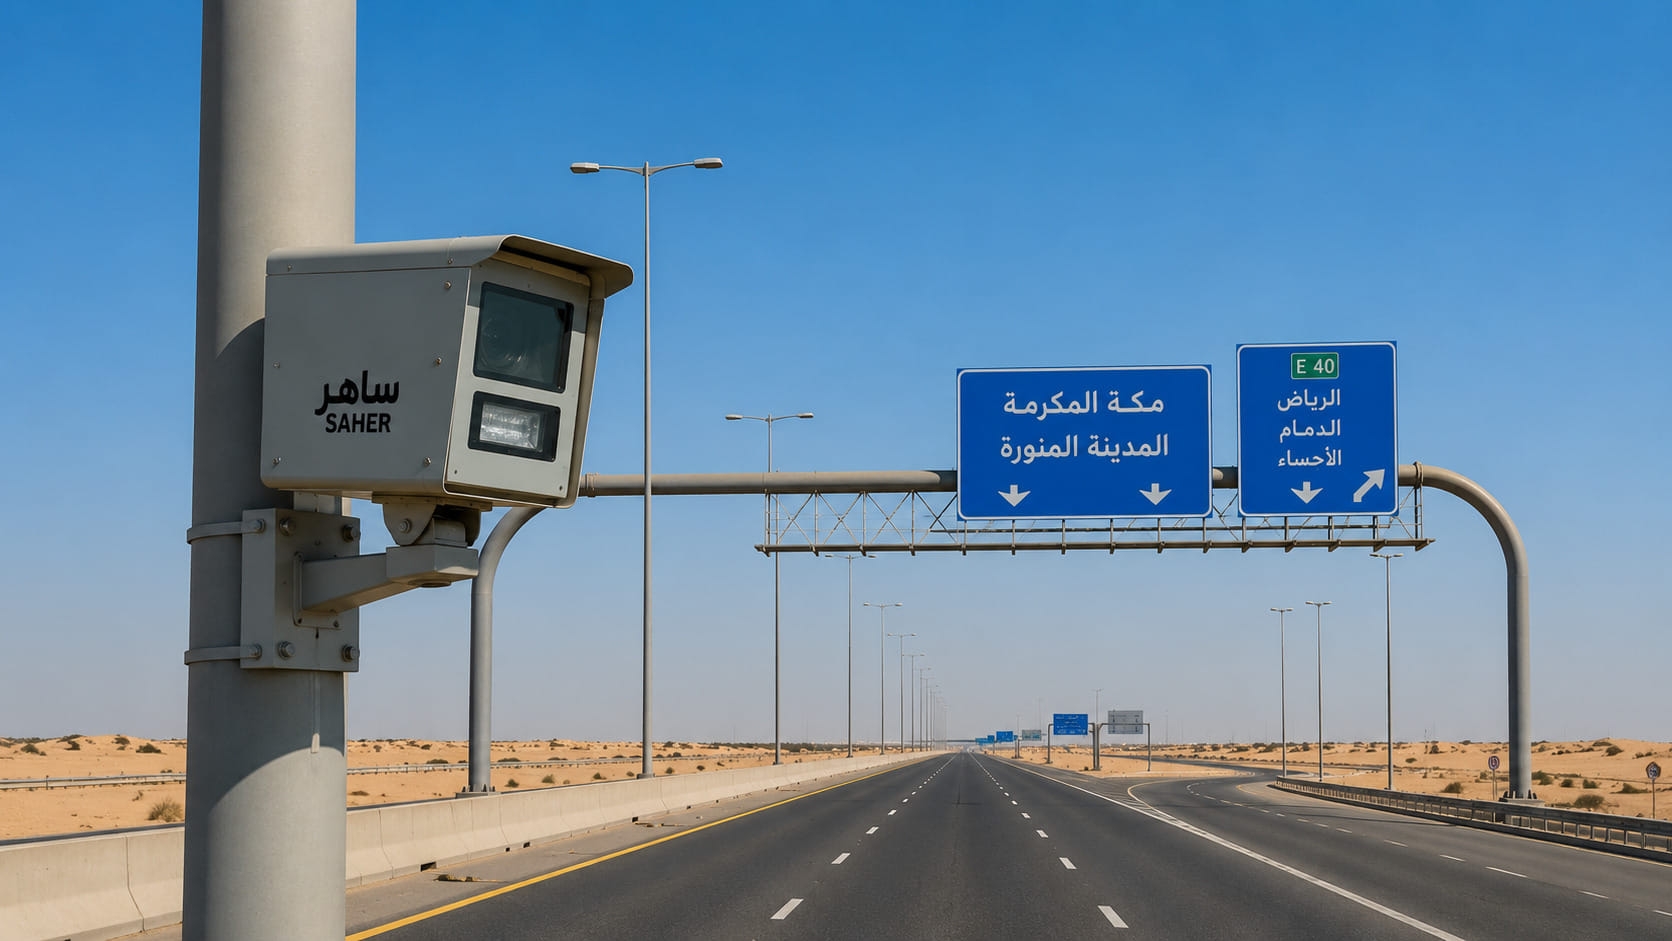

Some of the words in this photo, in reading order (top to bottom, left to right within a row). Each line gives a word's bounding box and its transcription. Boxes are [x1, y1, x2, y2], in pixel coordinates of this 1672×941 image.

[1296, 359, 1307, 374] E
[1313, 358, 1335, 374] 40
[314, 369, 400, 416] ساهر
[1107, 390, 1164, 413] مكة
[1277, 388, 1341, 412] الرياض
[1003, 390, 1098, 420] المكرمة
[325, 412, 392, 433] SAHER
[1279, 418, 1341, 443] الدمام
[1000, 434, 1078, 464] المنورة
[1087, 433, 1168, 463] المدينة
[1278, 446, 1342, 467] الأحساء
